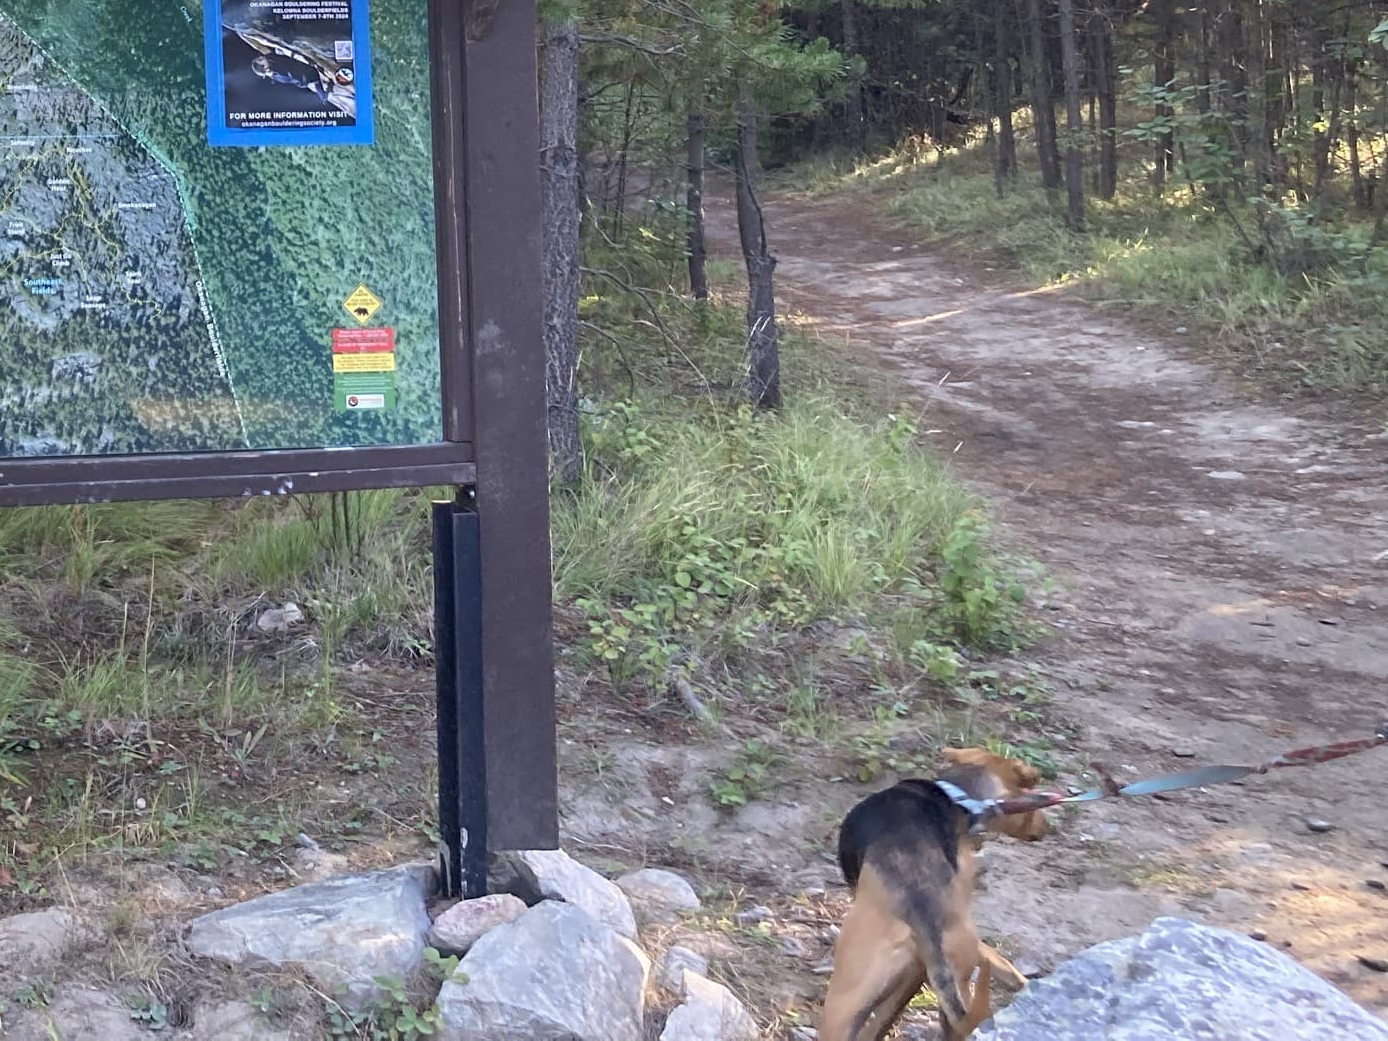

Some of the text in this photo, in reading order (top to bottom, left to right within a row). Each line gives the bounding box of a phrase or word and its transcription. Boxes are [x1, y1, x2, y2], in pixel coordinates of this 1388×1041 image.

[273, 111, 327, 119] INFORMATION
[241, 120, 337, 128] okanaganboulderingsociety.org
[23, 278, 62, 286] Southeast
[31, 287, 54, 295] Fields
